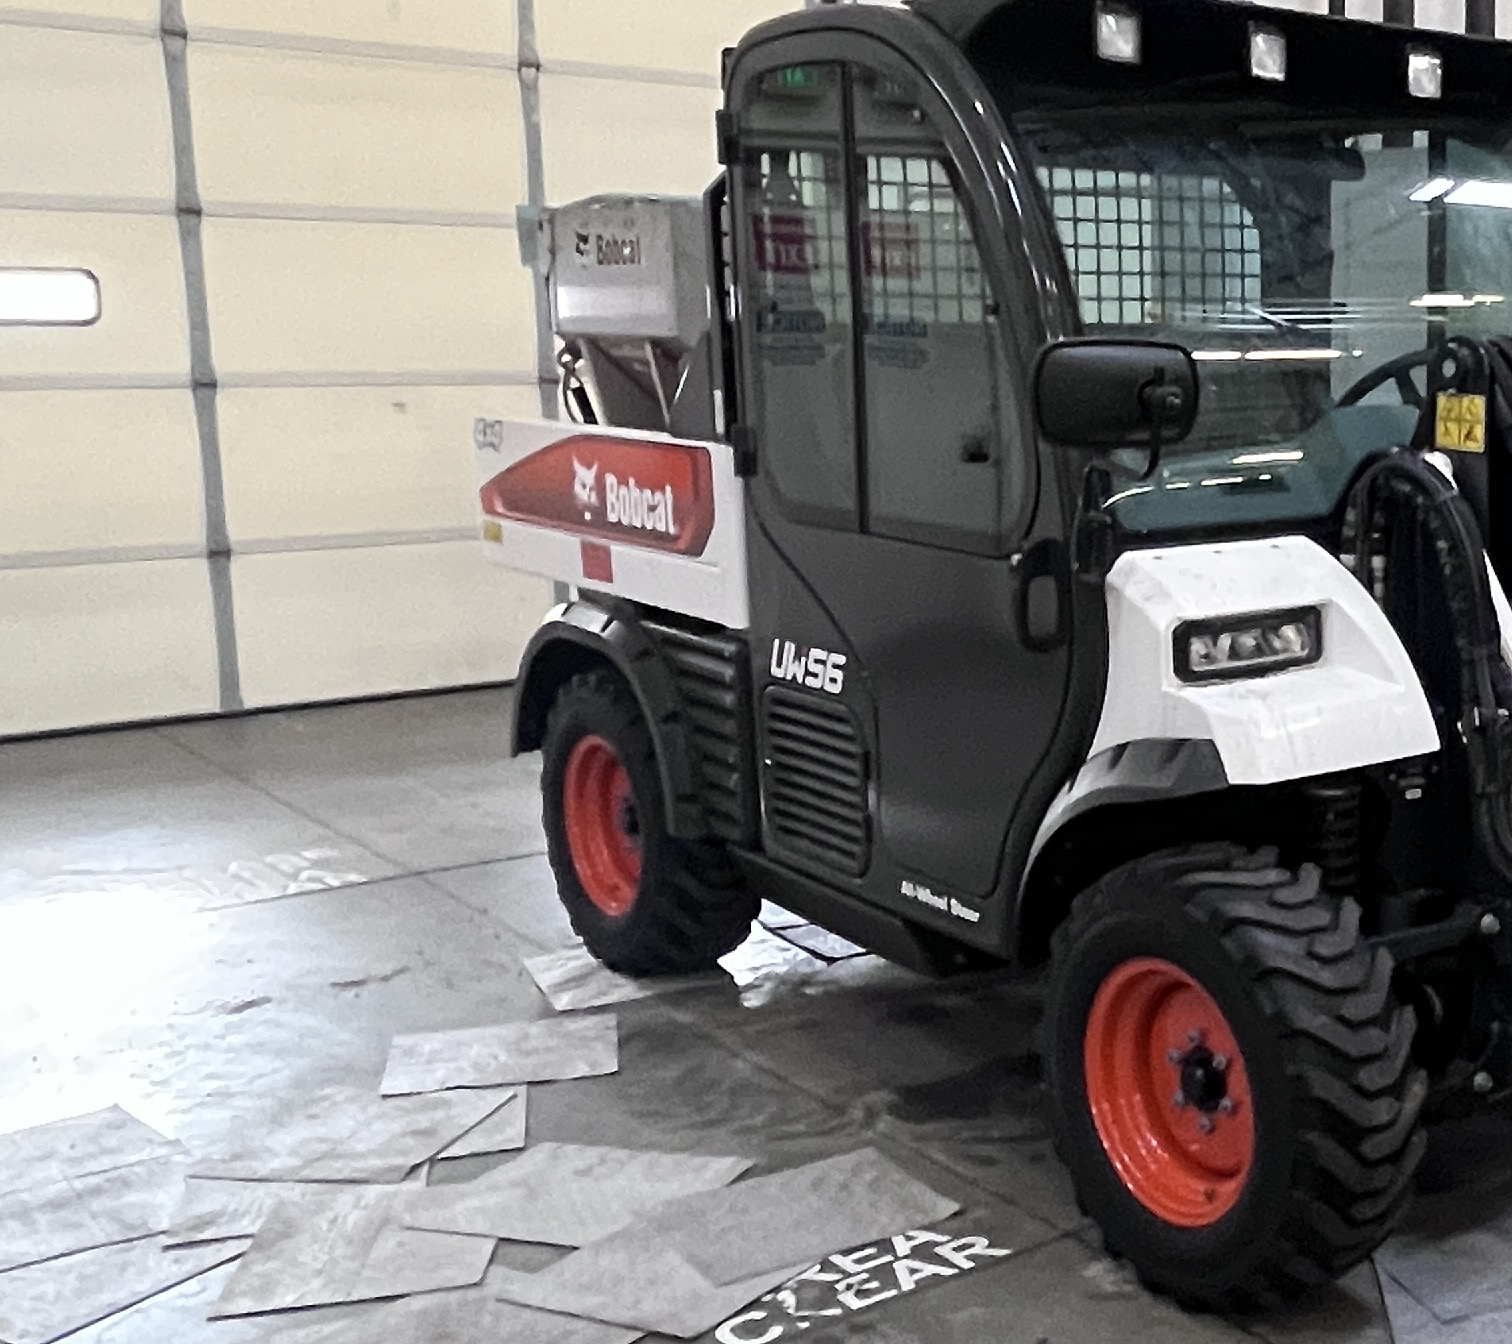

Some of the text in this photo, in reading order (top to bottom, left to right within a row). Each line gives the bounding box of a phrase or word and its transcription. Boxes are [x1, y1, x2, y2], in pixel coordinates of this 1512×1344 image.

[596, 233, 642, 266] Bobcat
[605, 472, 677, 535] Bobcat
[770, 638, 846, 695] UW56
